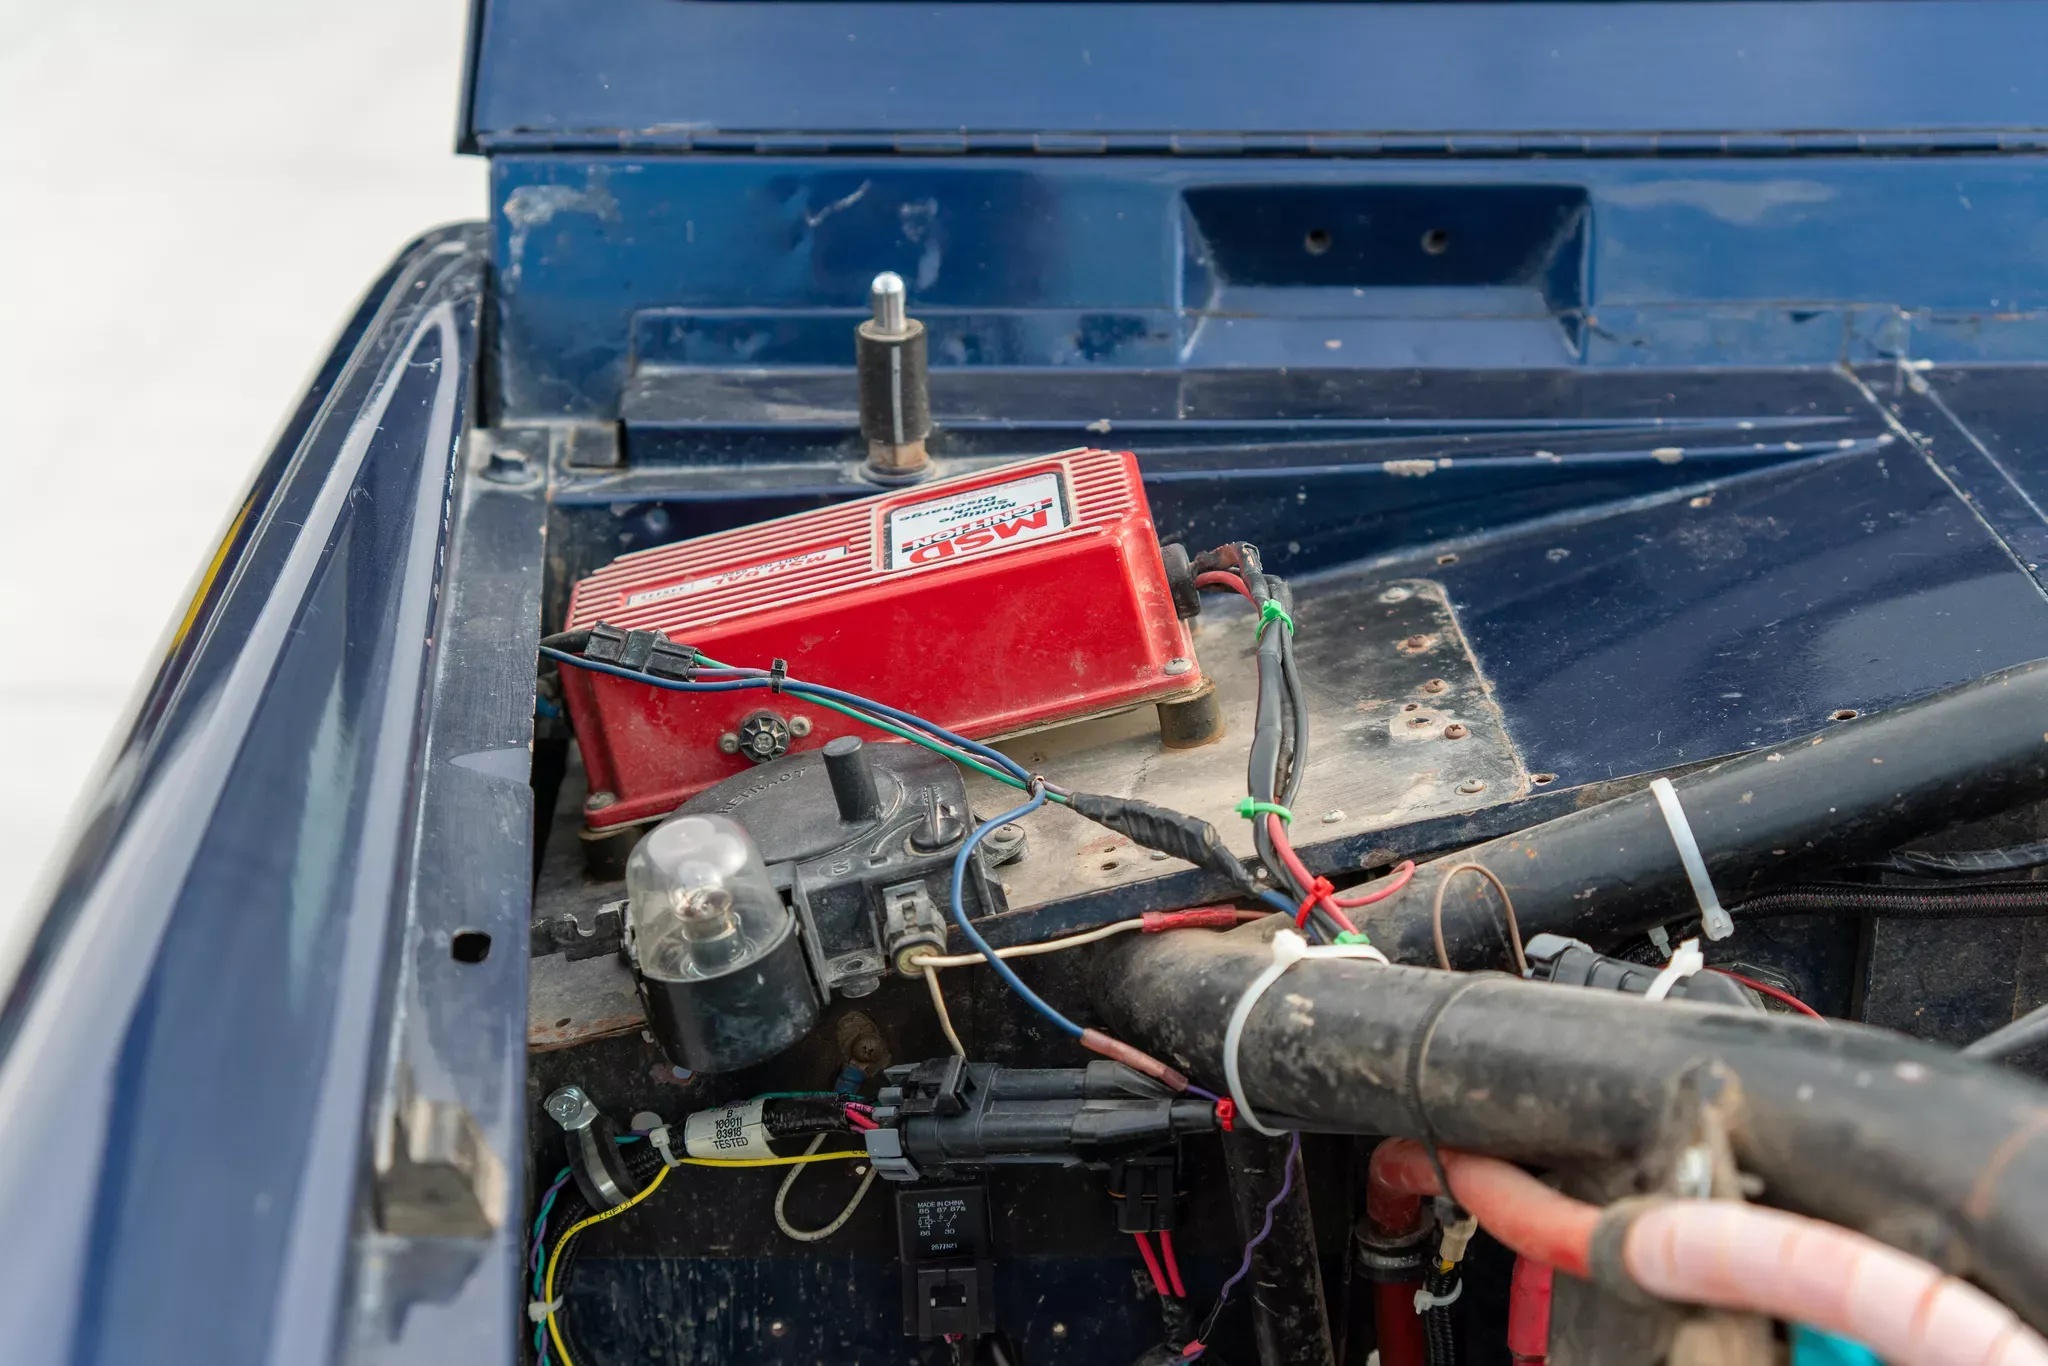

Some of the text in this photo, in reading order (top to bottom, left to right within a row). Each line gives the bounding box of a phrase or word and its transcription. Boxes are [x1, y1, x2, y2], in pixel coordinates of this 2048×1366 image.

[899, 495, 997, 522] Discharge
[939, 501, 1017, 524] Multiple
[953, 498, 1010, 515] Spark
[912, 502, 1045, 550] IGNITION
[909, 509, 1049, 564] MSD
[768, 553, 828, 573] MSD
[715, 1116, 743, 1130] 100011
[716, 1127, 742, 1139] 03918
[713, 1137, 749, 1150] TESTED
